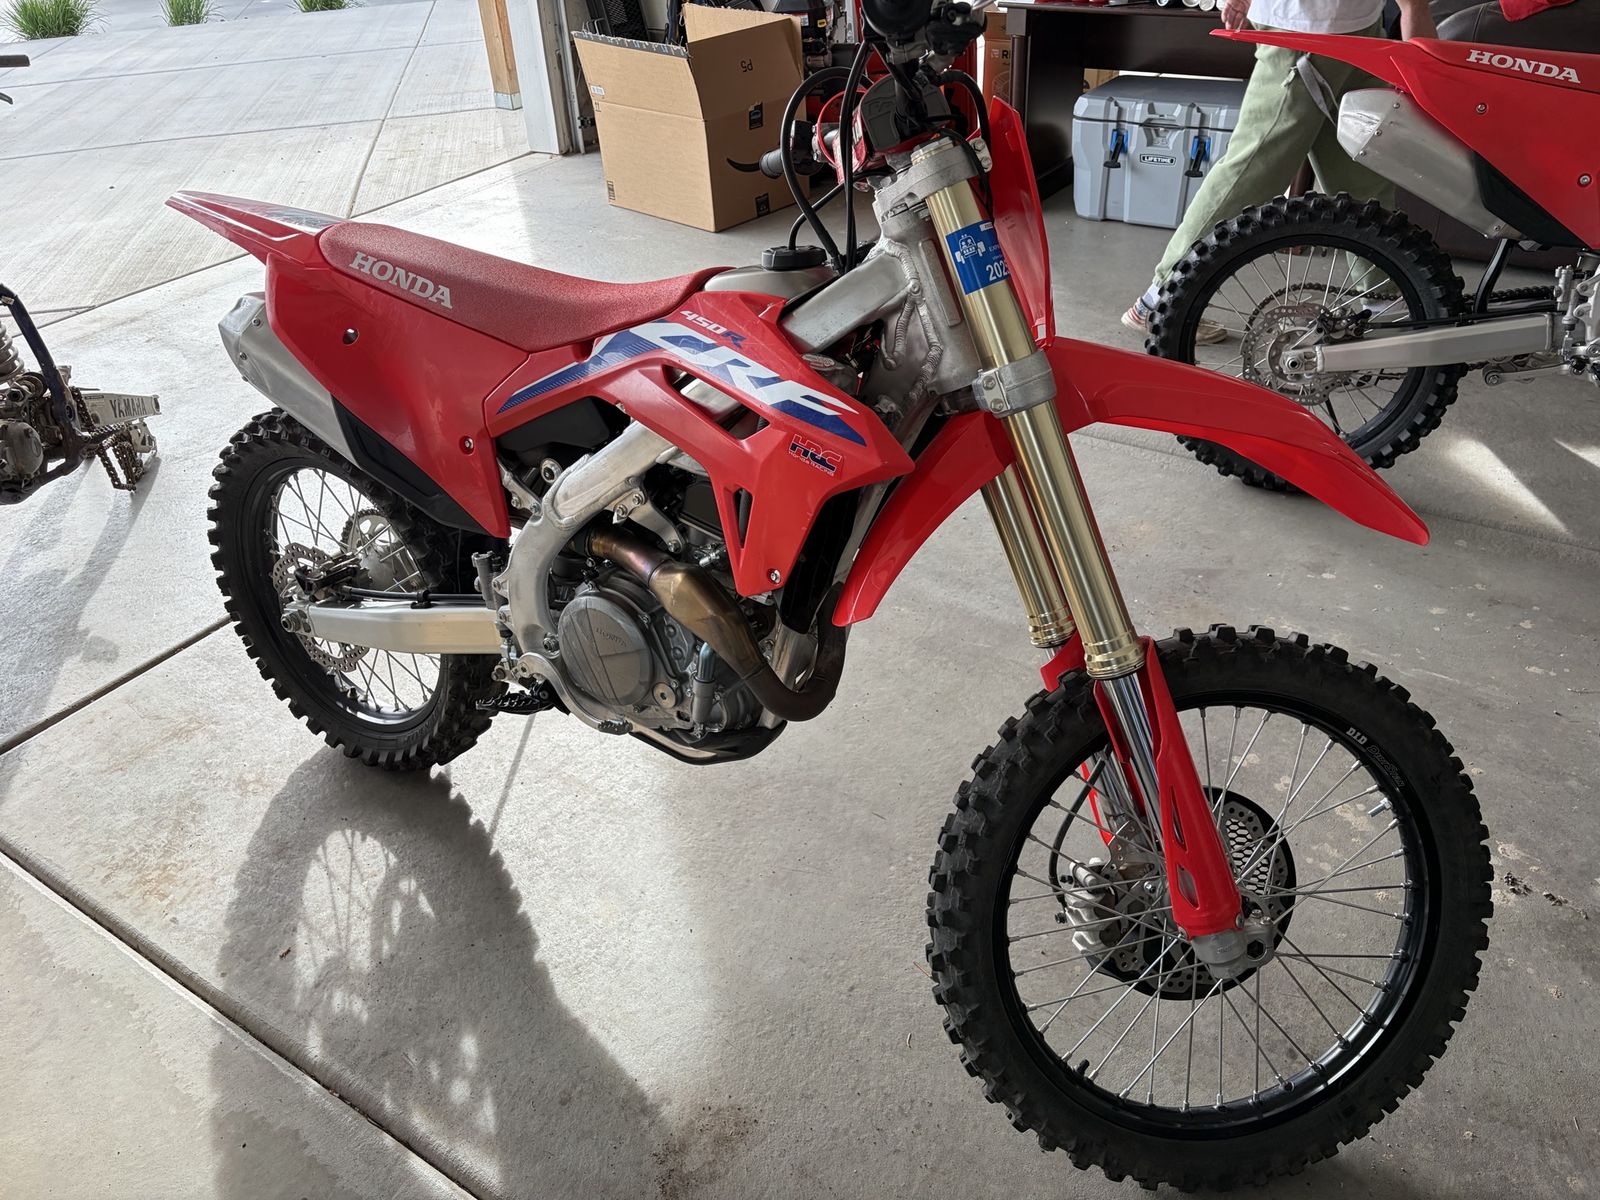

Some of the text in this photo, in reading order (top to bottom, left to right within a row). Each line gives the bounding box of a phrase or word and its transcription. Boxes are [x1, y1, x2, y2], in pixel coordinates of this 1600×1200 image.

[1466, 49, 1581, 84] HONDA
[1144, 155, 1171, 164] LIFETIME
[349, 250, 453, 309] HONDA
[986, 258, 1010, 281] 202
[680, 310, 748, 349] 450R
[629, 321, 860, 416] CRF
[109, 397, 148, 419] YAMAHA
[789, 433, 842, 473] HRC
